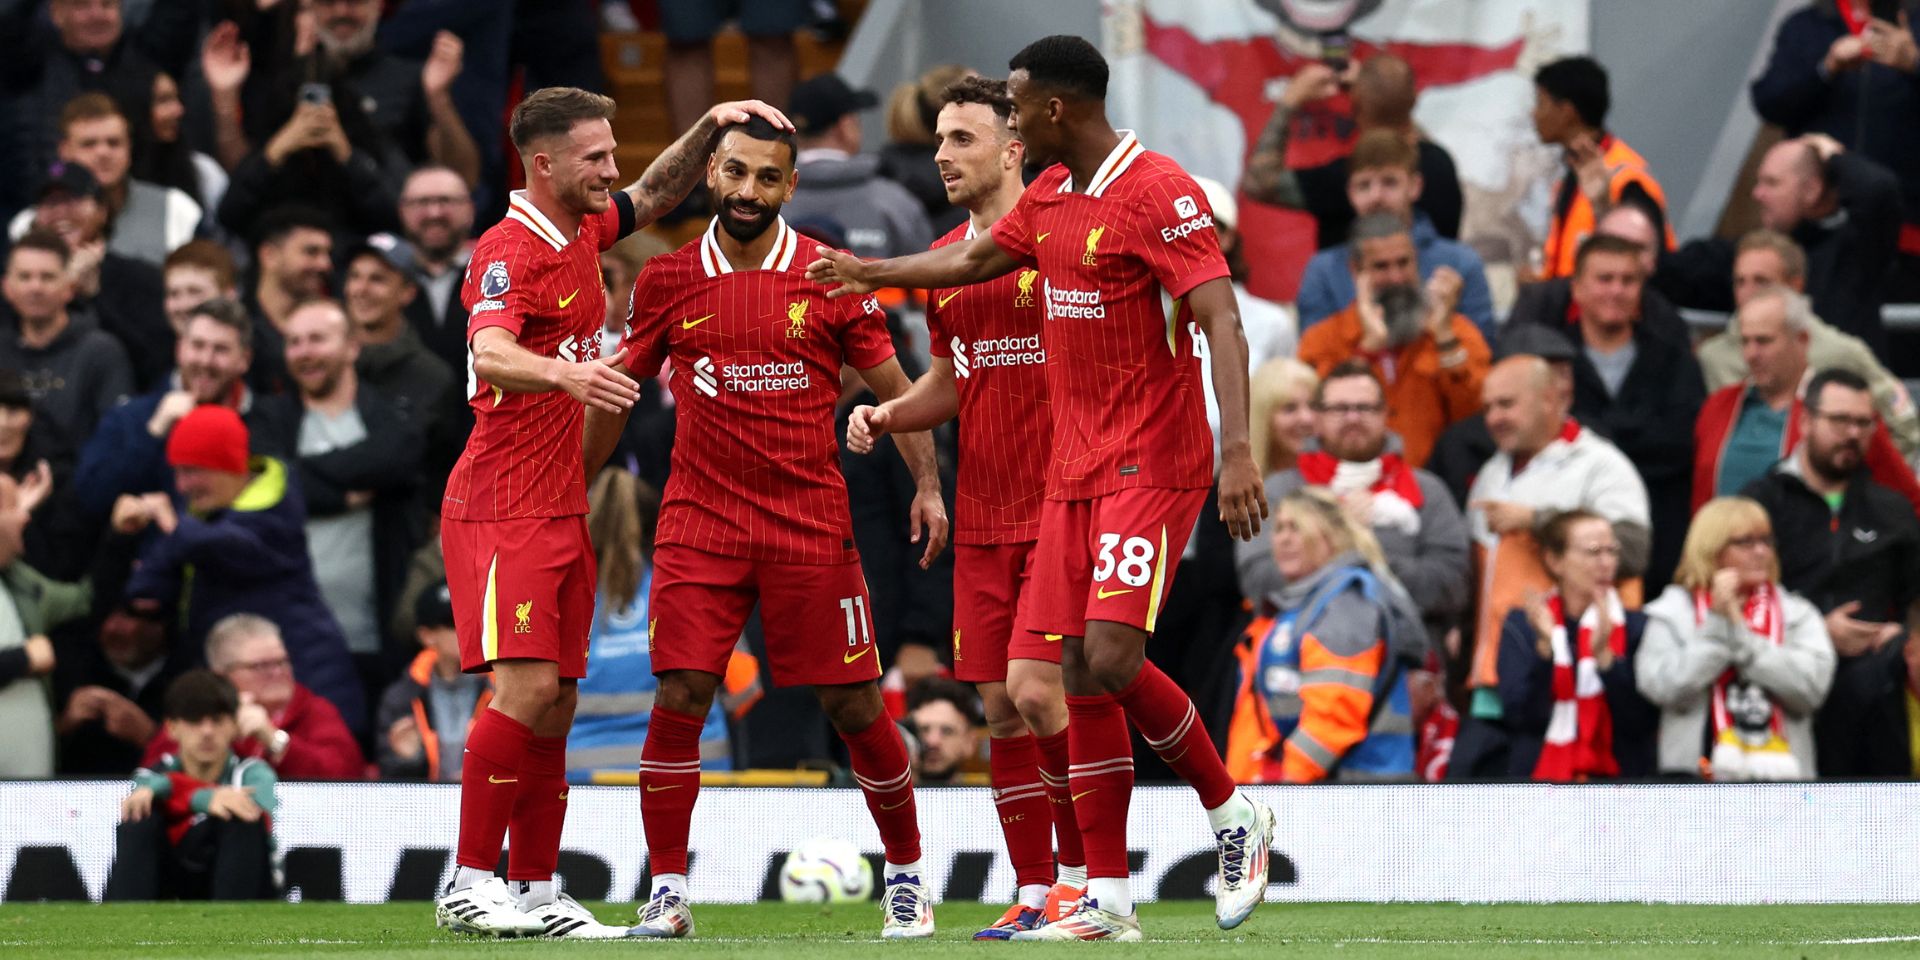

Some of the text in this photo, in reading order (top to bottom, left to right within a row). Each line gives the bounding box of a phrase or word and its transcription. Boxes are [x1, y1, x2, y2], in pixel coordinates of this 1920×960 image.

[972, 334, 1039, 355] standard
[723, 360, 804, 377] standard
[972, 348, 1046, 369] chartered
[724, 374, 809, 392] chartered
[1093, 533, 1155, 587] 38
[840, 595, 869, 646] 11
[1002, 813, 1025, 824] LFC
